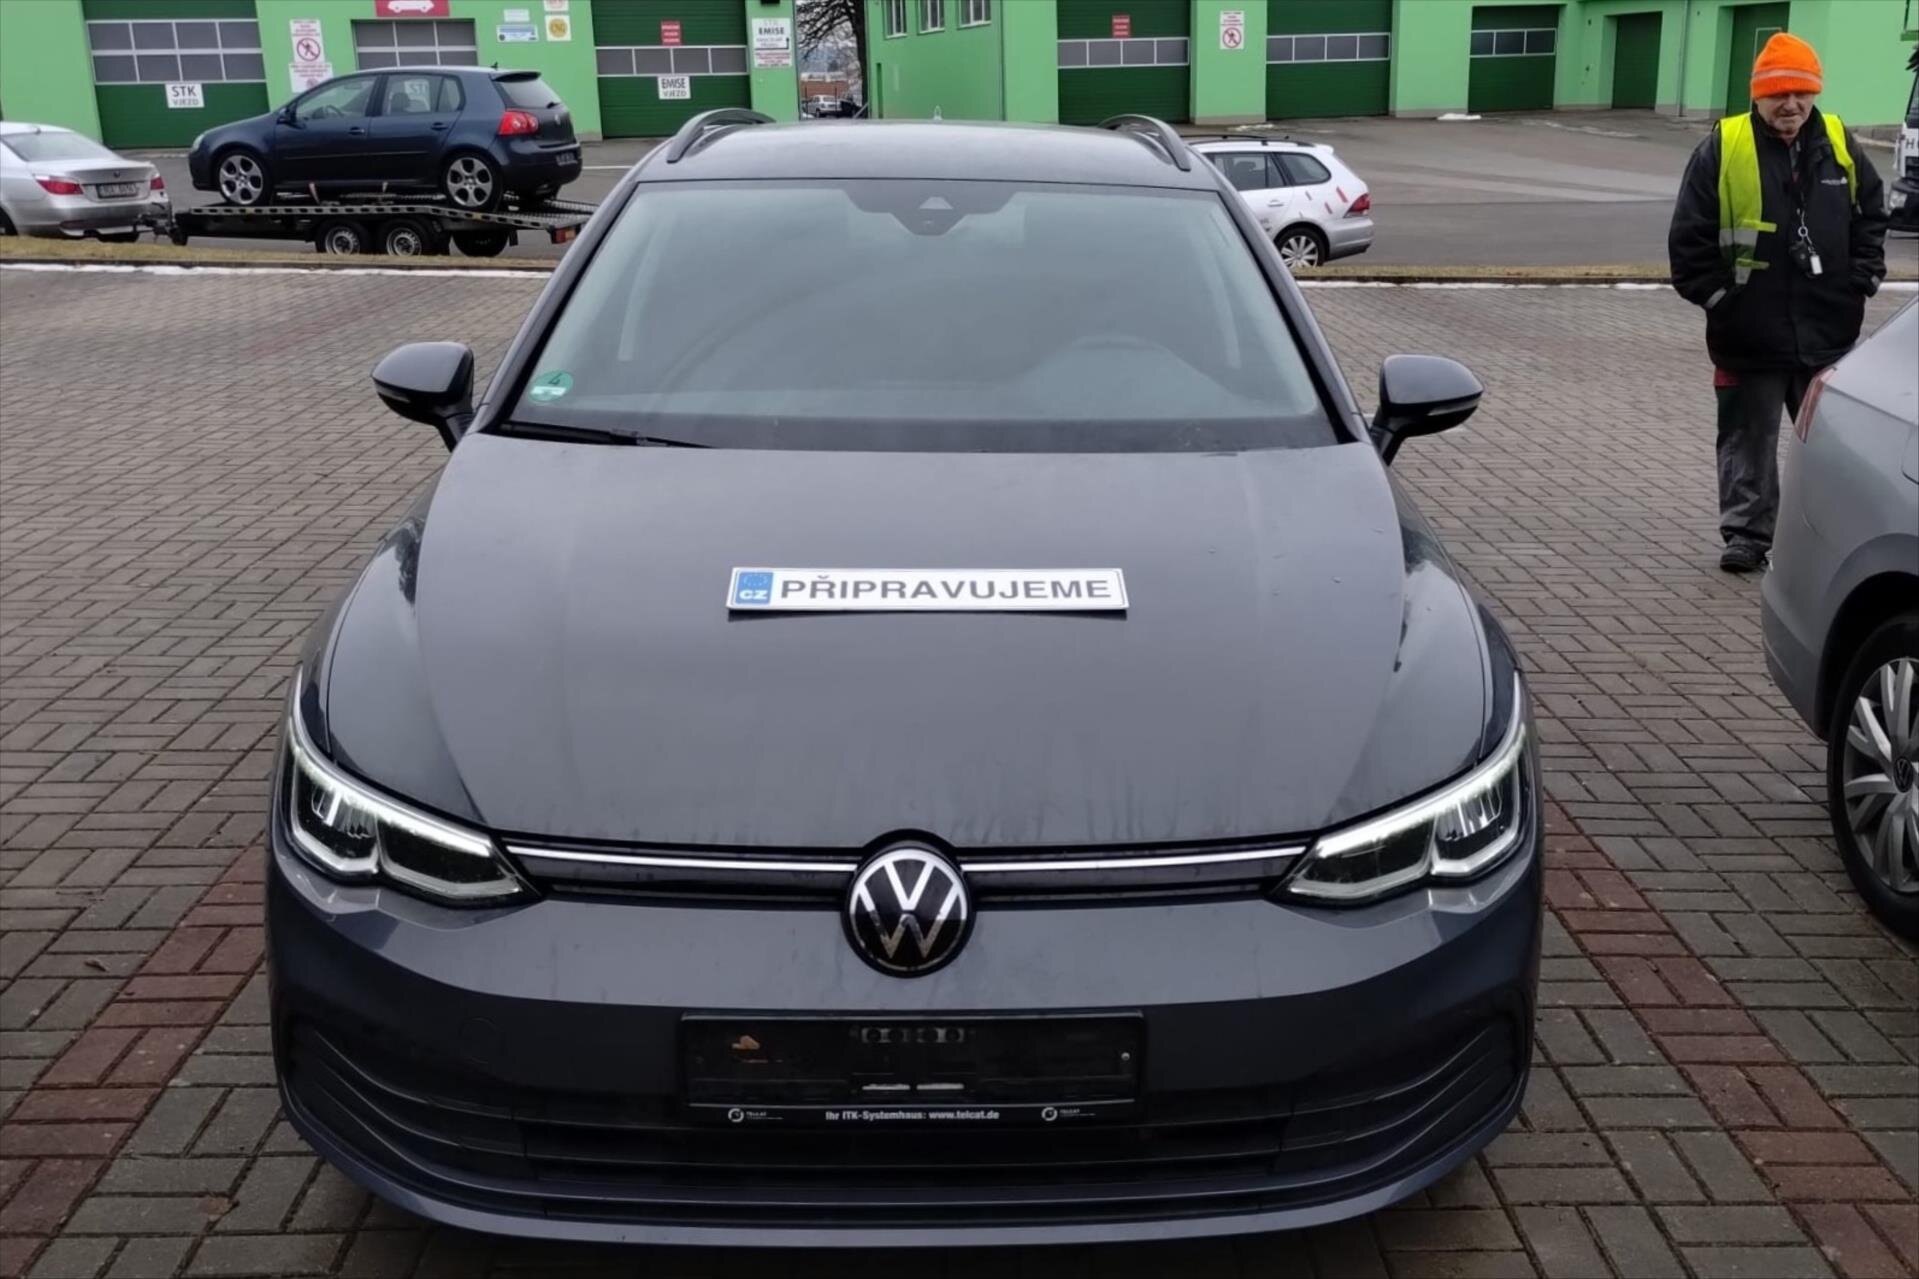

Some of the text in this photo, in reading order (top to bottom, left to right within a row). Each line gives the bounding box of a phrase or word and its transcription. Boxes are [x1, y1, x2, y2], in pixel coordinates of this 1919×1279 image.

[758, 27, 785, 35] EMISE
[661, 78, 686, 89] EMISE
[171, 85, 197, 97] STK
[738, 575, 1112, 600] CZ PŘIPRAVUJEME
[825, 1110, 1000, 1122] Ihr ITK-Systemhaus: www.telcat.de
